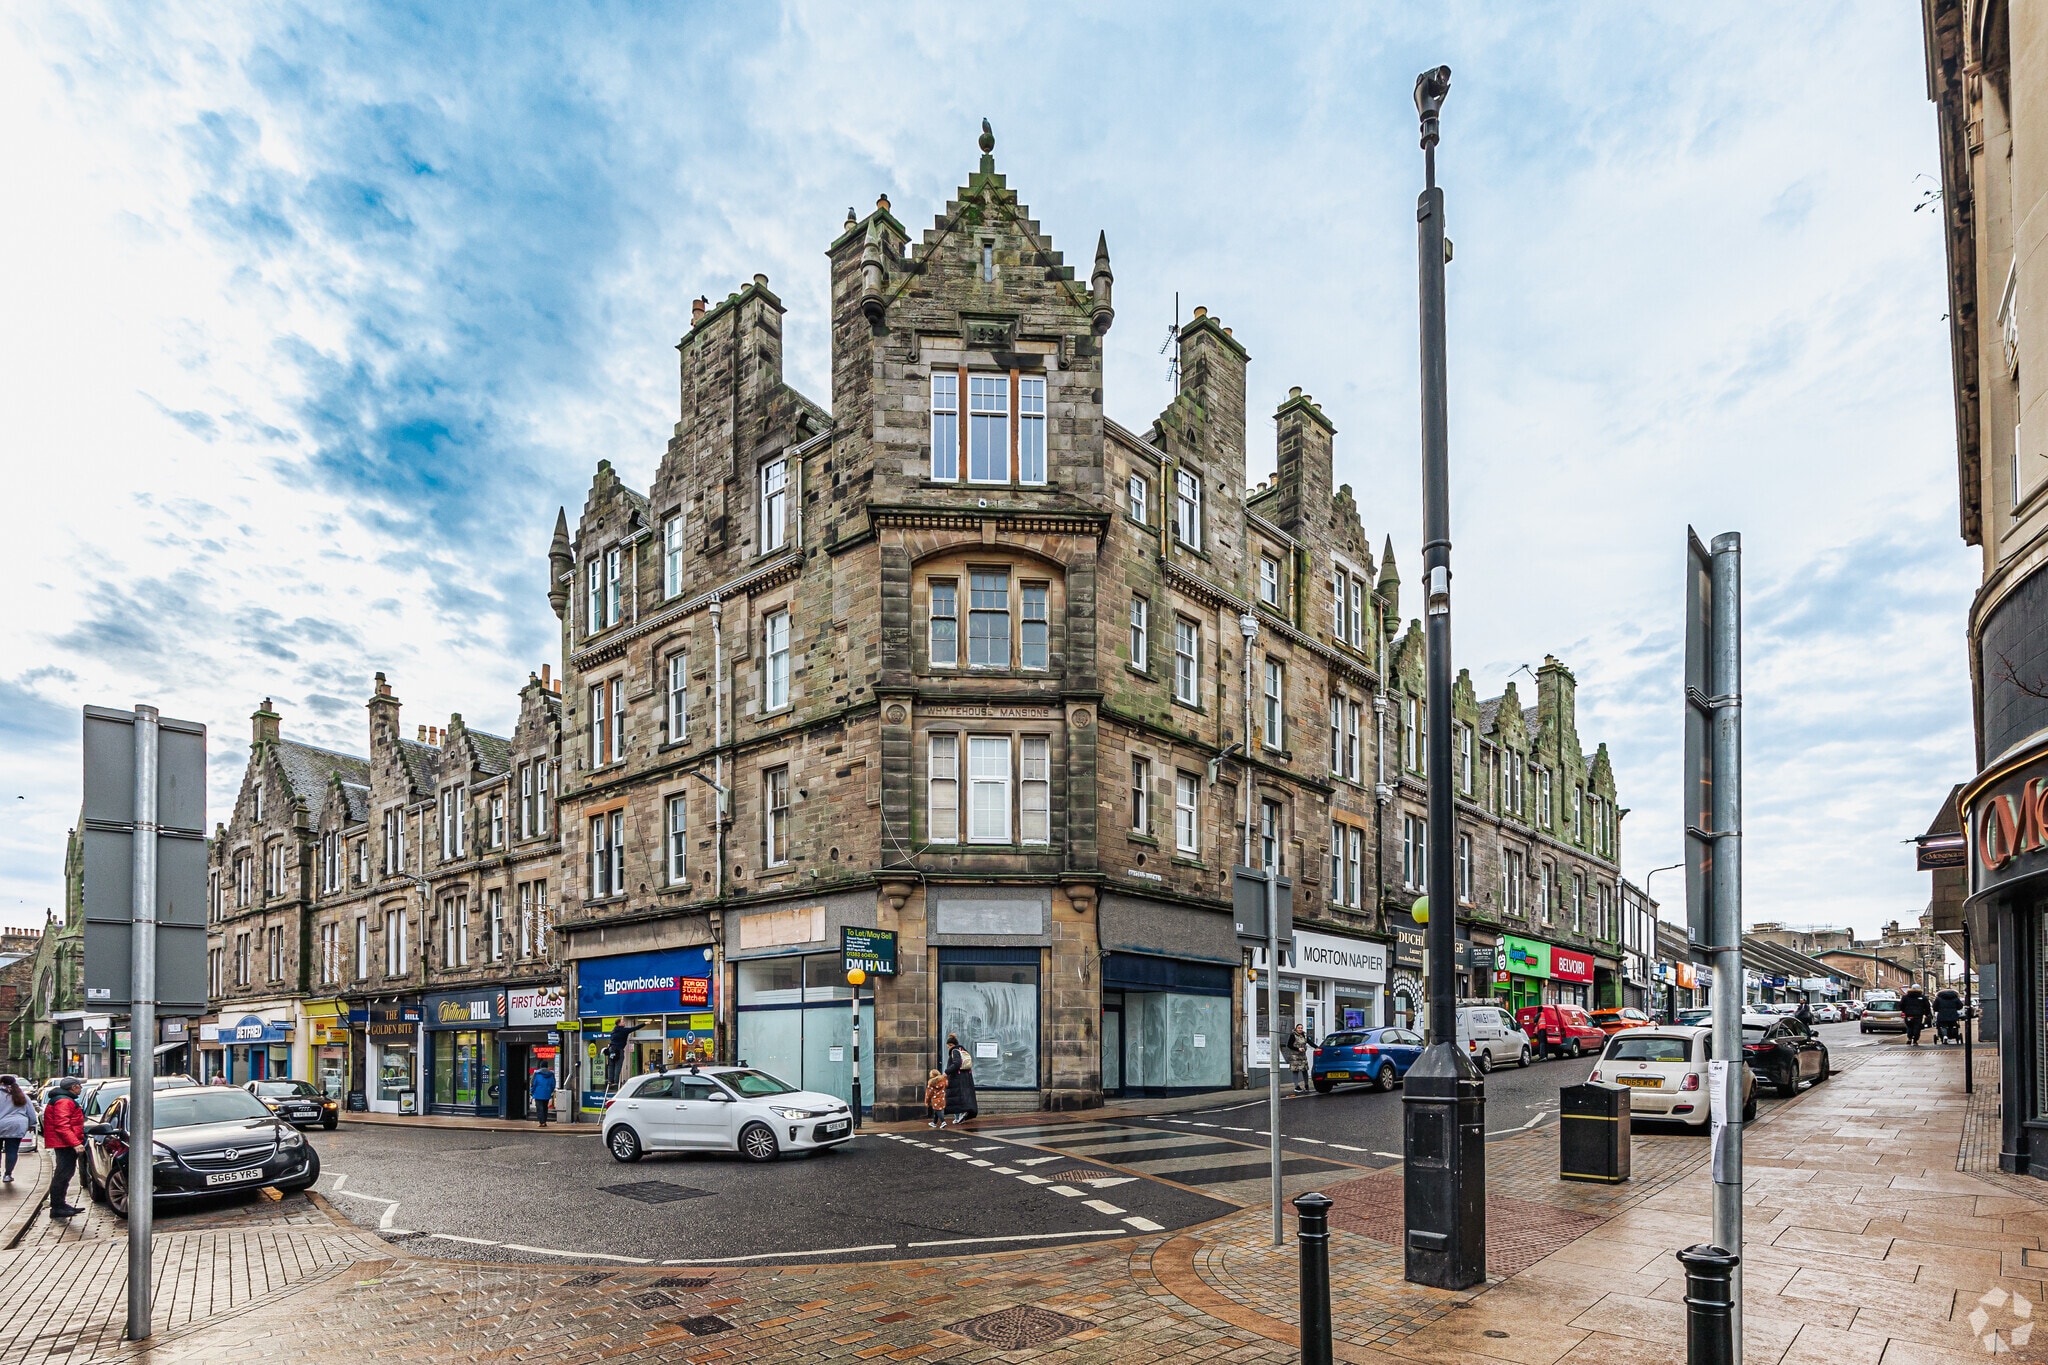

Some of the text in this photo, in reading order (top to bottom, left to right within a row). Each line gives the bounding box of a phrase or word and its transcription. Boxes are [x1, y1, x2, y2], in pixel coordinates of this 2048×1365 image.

[926, 706, 1049, 717] WHYTEHOUSE MANSIONS
[847, 928, 854, 936] To
[881, 932, 892, 940] Sell
[846, 958, 893, 972] DM HALL
[1303, 946, 1348, 967] MORTON
[1349, 951, 1383, 971] NAPIER
[1558, 957, 1585, 976] BELVOIR!
[616, 975, 674, 992] pawnbrokers
[511, 995, 535, 1009] FIRST
[385, 1010, 398, 1020] THE
[470, 1000, 491, 1020] HILL
[533, 1008, 563, 1019] BARBERS
[236, 1025, 263, 1040] BETFRED
[371, 1023, 413, 1035] GOLDEN BITE
[211, 1169, 259, 1183] SG65 YRS
